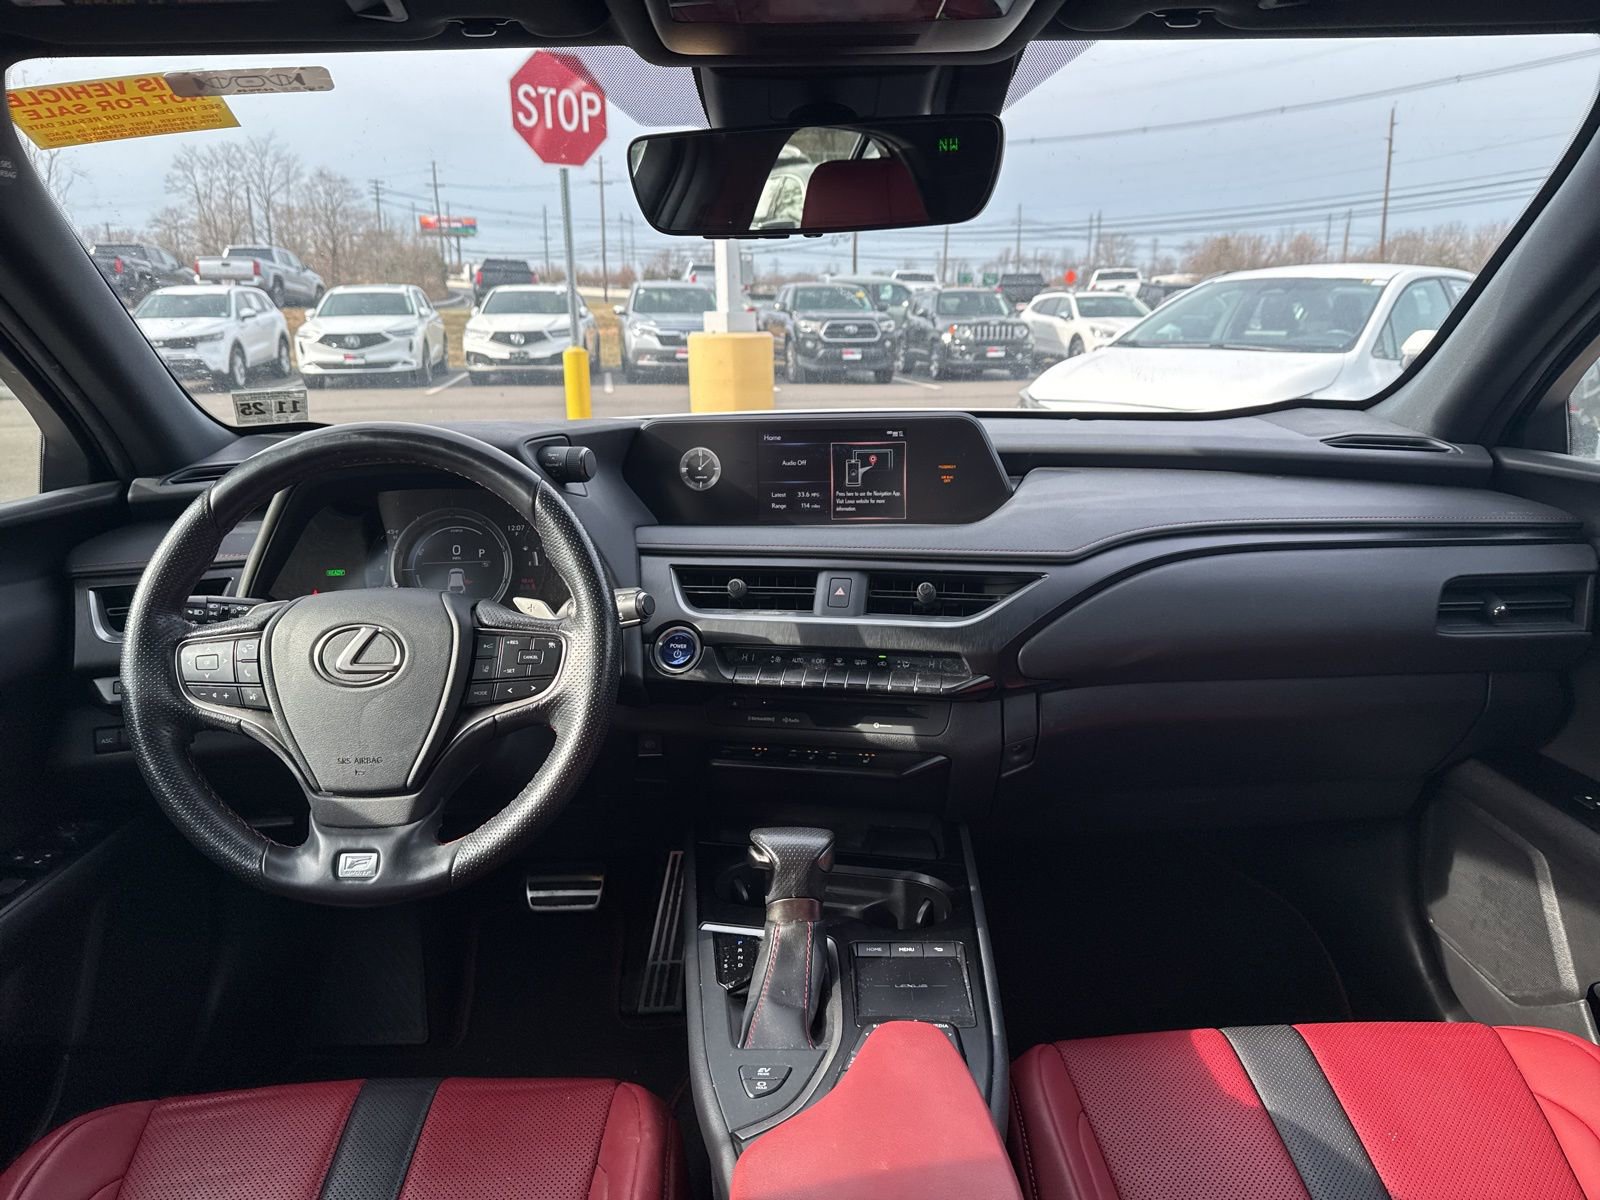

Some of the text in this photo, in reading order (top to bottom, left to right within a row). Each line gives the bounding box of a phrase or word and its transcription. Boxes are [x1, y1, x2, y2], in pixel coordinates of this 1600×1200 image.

[517, 83, 602, 133] STOP
[939, 137, 958, 152] NW
[507, 524, 525, 532] 12:07
[478, 548, 486, 558] P
[338, 757, 383, 765] SRS AIRBAG
